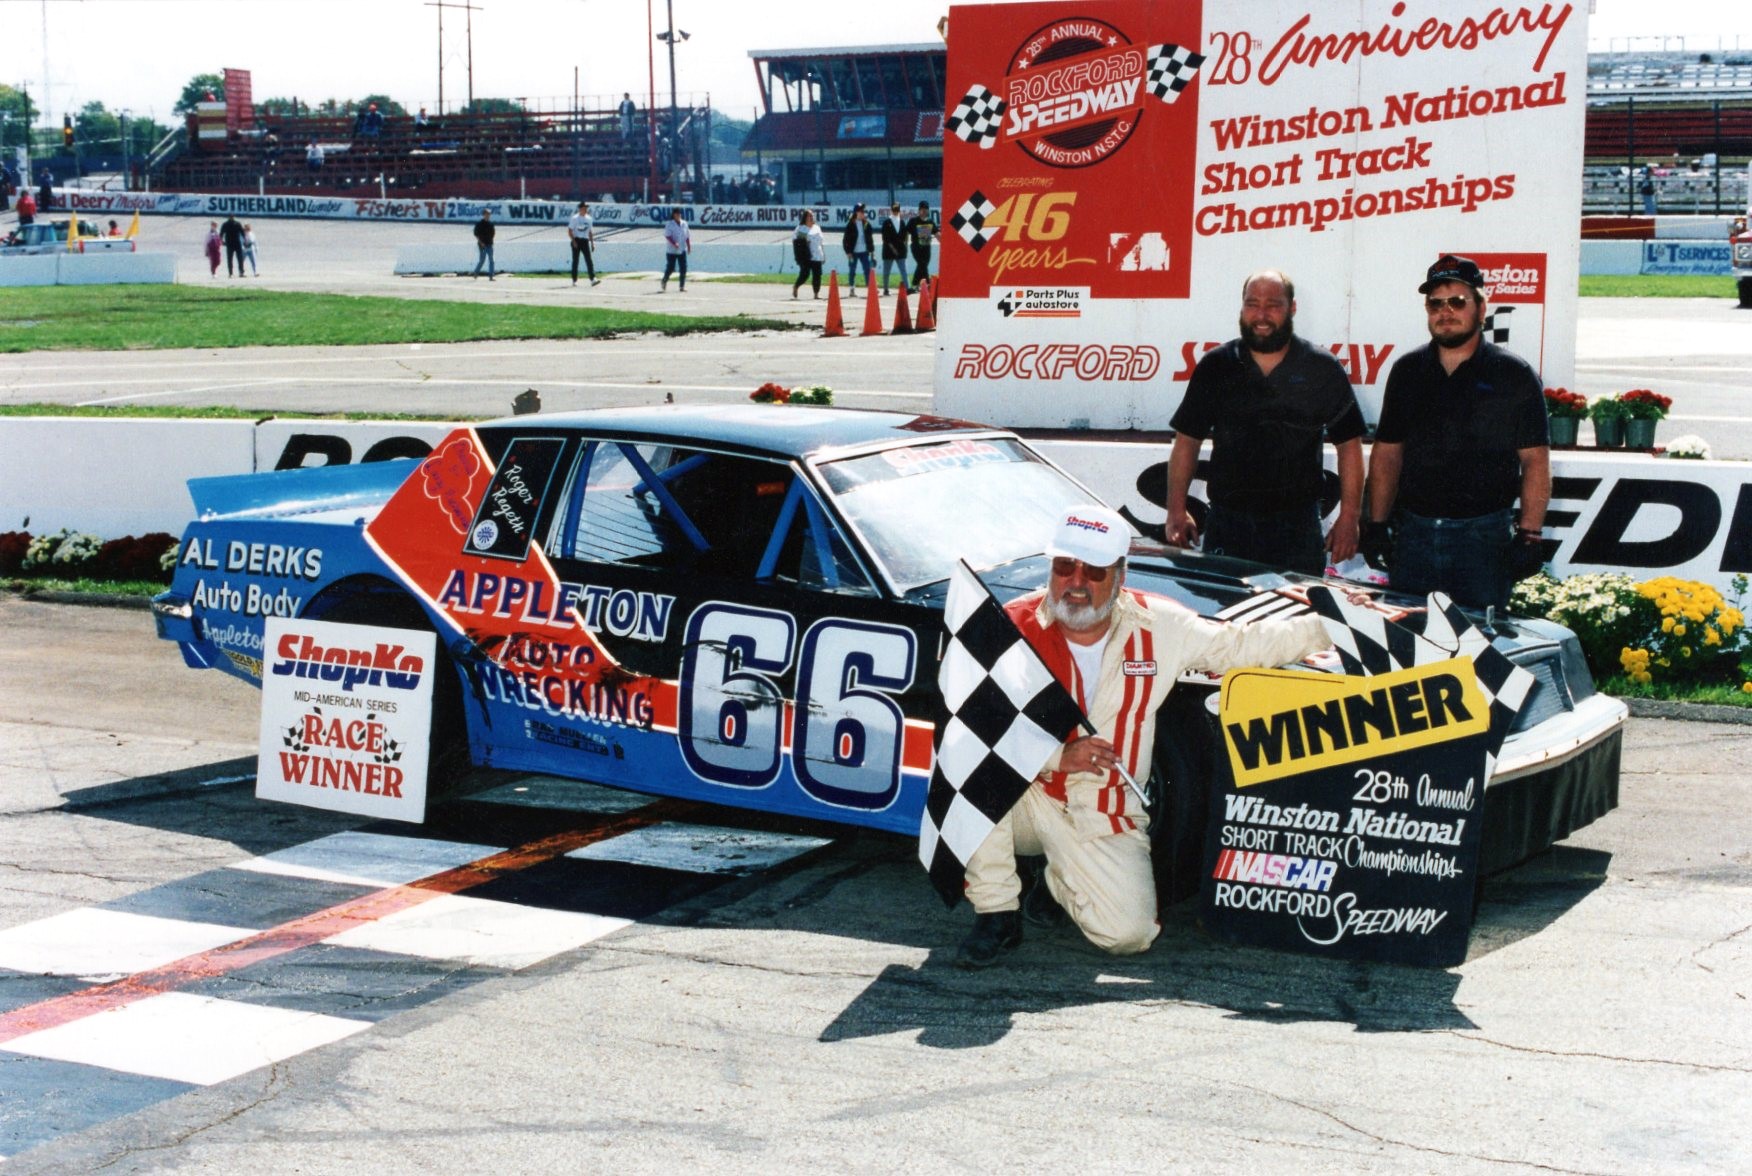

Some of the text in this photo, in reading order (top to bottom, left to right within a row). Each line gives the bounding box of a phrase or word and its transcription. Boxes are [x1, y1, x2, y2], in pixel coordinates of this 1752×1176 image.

[1050, 23, 1104, 42] ANNUAL
[1009, 50, 1143, 107] ROCKFORD
[1006, 76, 1142, 137] SPEEDWAY
[1210, 72, 1567, 151] Winston National
[1034, 140, 1092, 164] WINSTON
[1201, 136, 1433, 196] Short Track
[71, 194, 113, 208] Deery
[996, 177, 1055, 189] CELEBRATING
[207, 196, 307, 213] SUTHERLAND
[355, 199, 421, 219] Fisher's
[508, 204, 556, 220] WLUV
[700, 206, 754, 224] Erickson
[756, 208, 787, 222] AUTO
[981, 192, 1077, 242] 46
[1195, 174, 1516, 237] Championships
[988, 246, 1097, 284] years
[1479, 263, 1539, 283] nston
[1679, 247, 1731, 261] SERVICES
[1025, 300, 1079, 309] autostore
[1026, 289, 1080, 299] Parts Plus
[1495, 283, 1537, 294] Series
[954, 344, 1161, 381] ROCKFORD
[504, 464, 533, 504] Roger
[492, 486, 525, 534] Regeth
[1065, 515, 1109, 534] ShopKo
[182, 537, 323, 579] AL DERKS
[193, 579, 302, 618] Auto Body
[437, 569, 676, 643] APPLETON
[272, 633, 424, 692] ShopKo
[498, 634, 595, 677] AUTO
[294, 691, 398, 713] MID-AMERICAN SERIES
[474, 662, 655, 732] WRECKING
[677, 600, 918, 813] 66
[303, 713, 385, 754] RACE
[1227, 672, 1474, 771] WINNER
[279, 751, 404, 798] WINNER
[1352, 769, 1409, 803] 28th
[1225, 794, 1466, 846] Winston National
[1221, 825, 1463, 882] SHORT TRACK Championships
[1228, 852, 1338, 892] NASCAR
[1215, 882, 1331, 918] ROCKFORD
